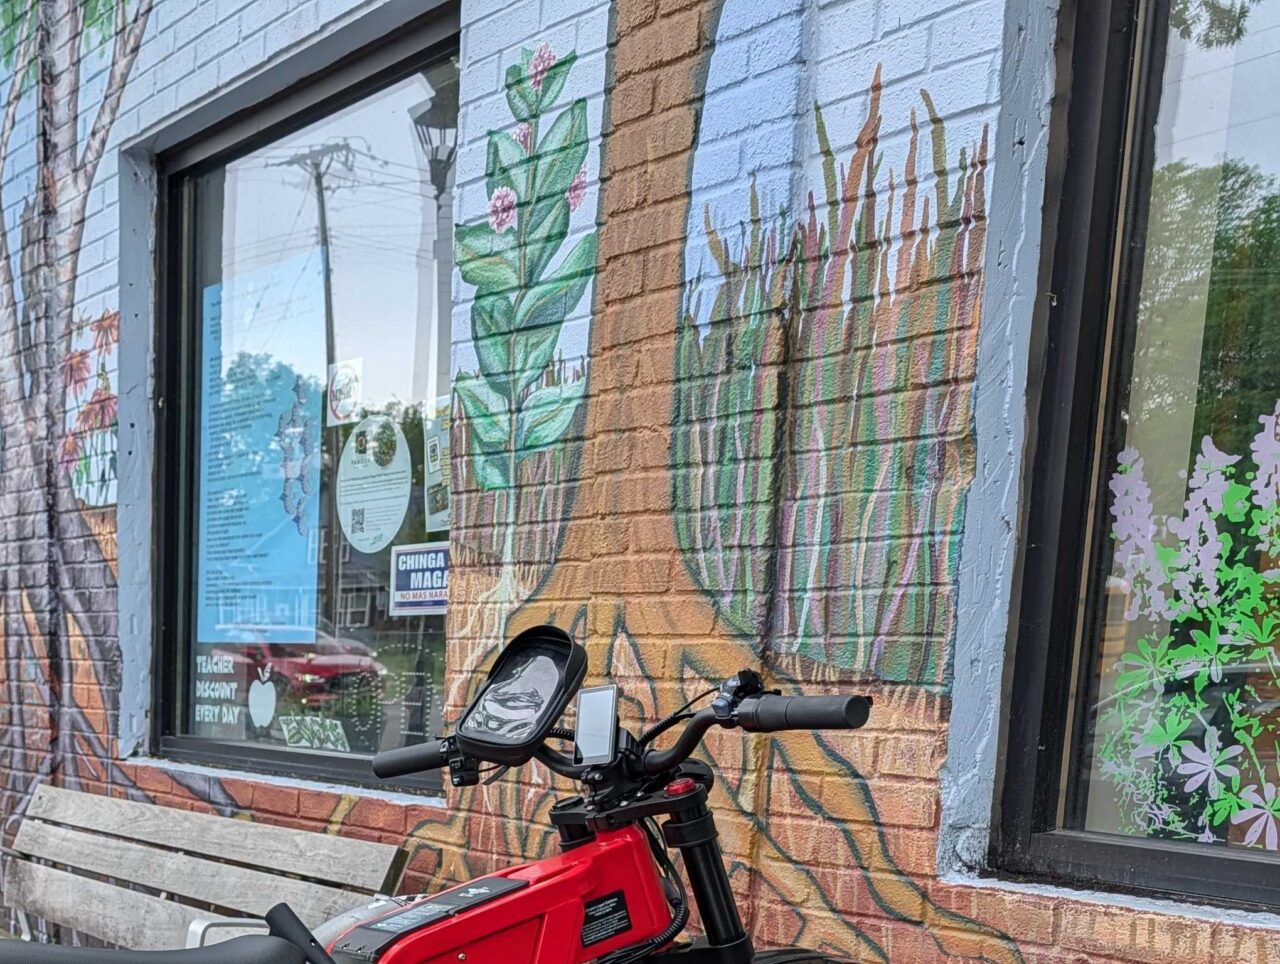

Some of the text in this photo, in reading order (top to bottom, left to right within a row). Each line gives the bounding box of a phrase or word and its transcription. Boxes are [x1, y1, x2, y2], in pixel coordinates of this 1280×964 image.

[398, 551, 445, 570] CHINGA
[410, 570, 449, 589] MAGA
[400, 592, 410, 600] NO
[412, 591, 427, 600] MAS
[196, 655, 234, 674] TEACHER
[195, 680, 238, 700] DISCOUNT
[195, 704, 240, 724] EVERY DAY
